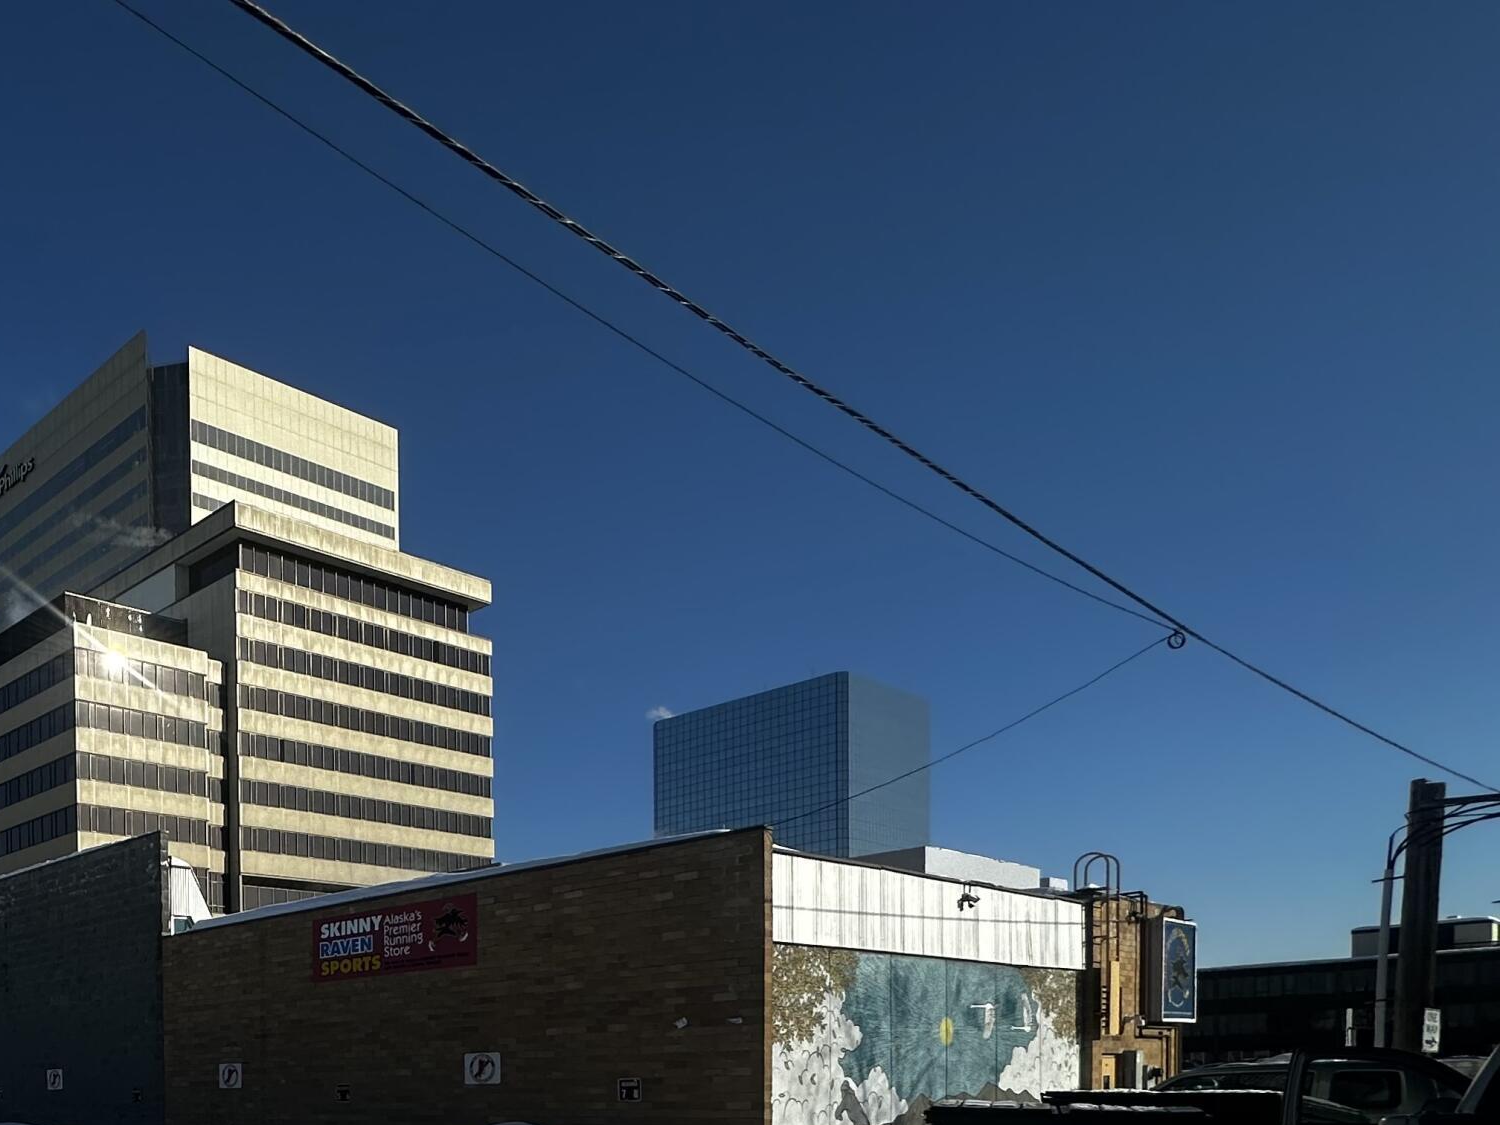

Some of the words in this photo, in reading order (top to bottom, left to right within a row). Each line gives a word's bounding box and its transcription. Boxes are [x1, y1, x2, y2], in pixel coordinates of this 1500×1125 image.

[384, 910, 423, 925] Alaska's
[320, 914, 383, 939] SKINNY
[384, 921, 422, 936] Premier
[319, 934, 374, 959] RAVEN
[384, 932, 424, 946] Running
[384, 945, 411, 957] Store
[320, 955, 382, 977] SPORTS
